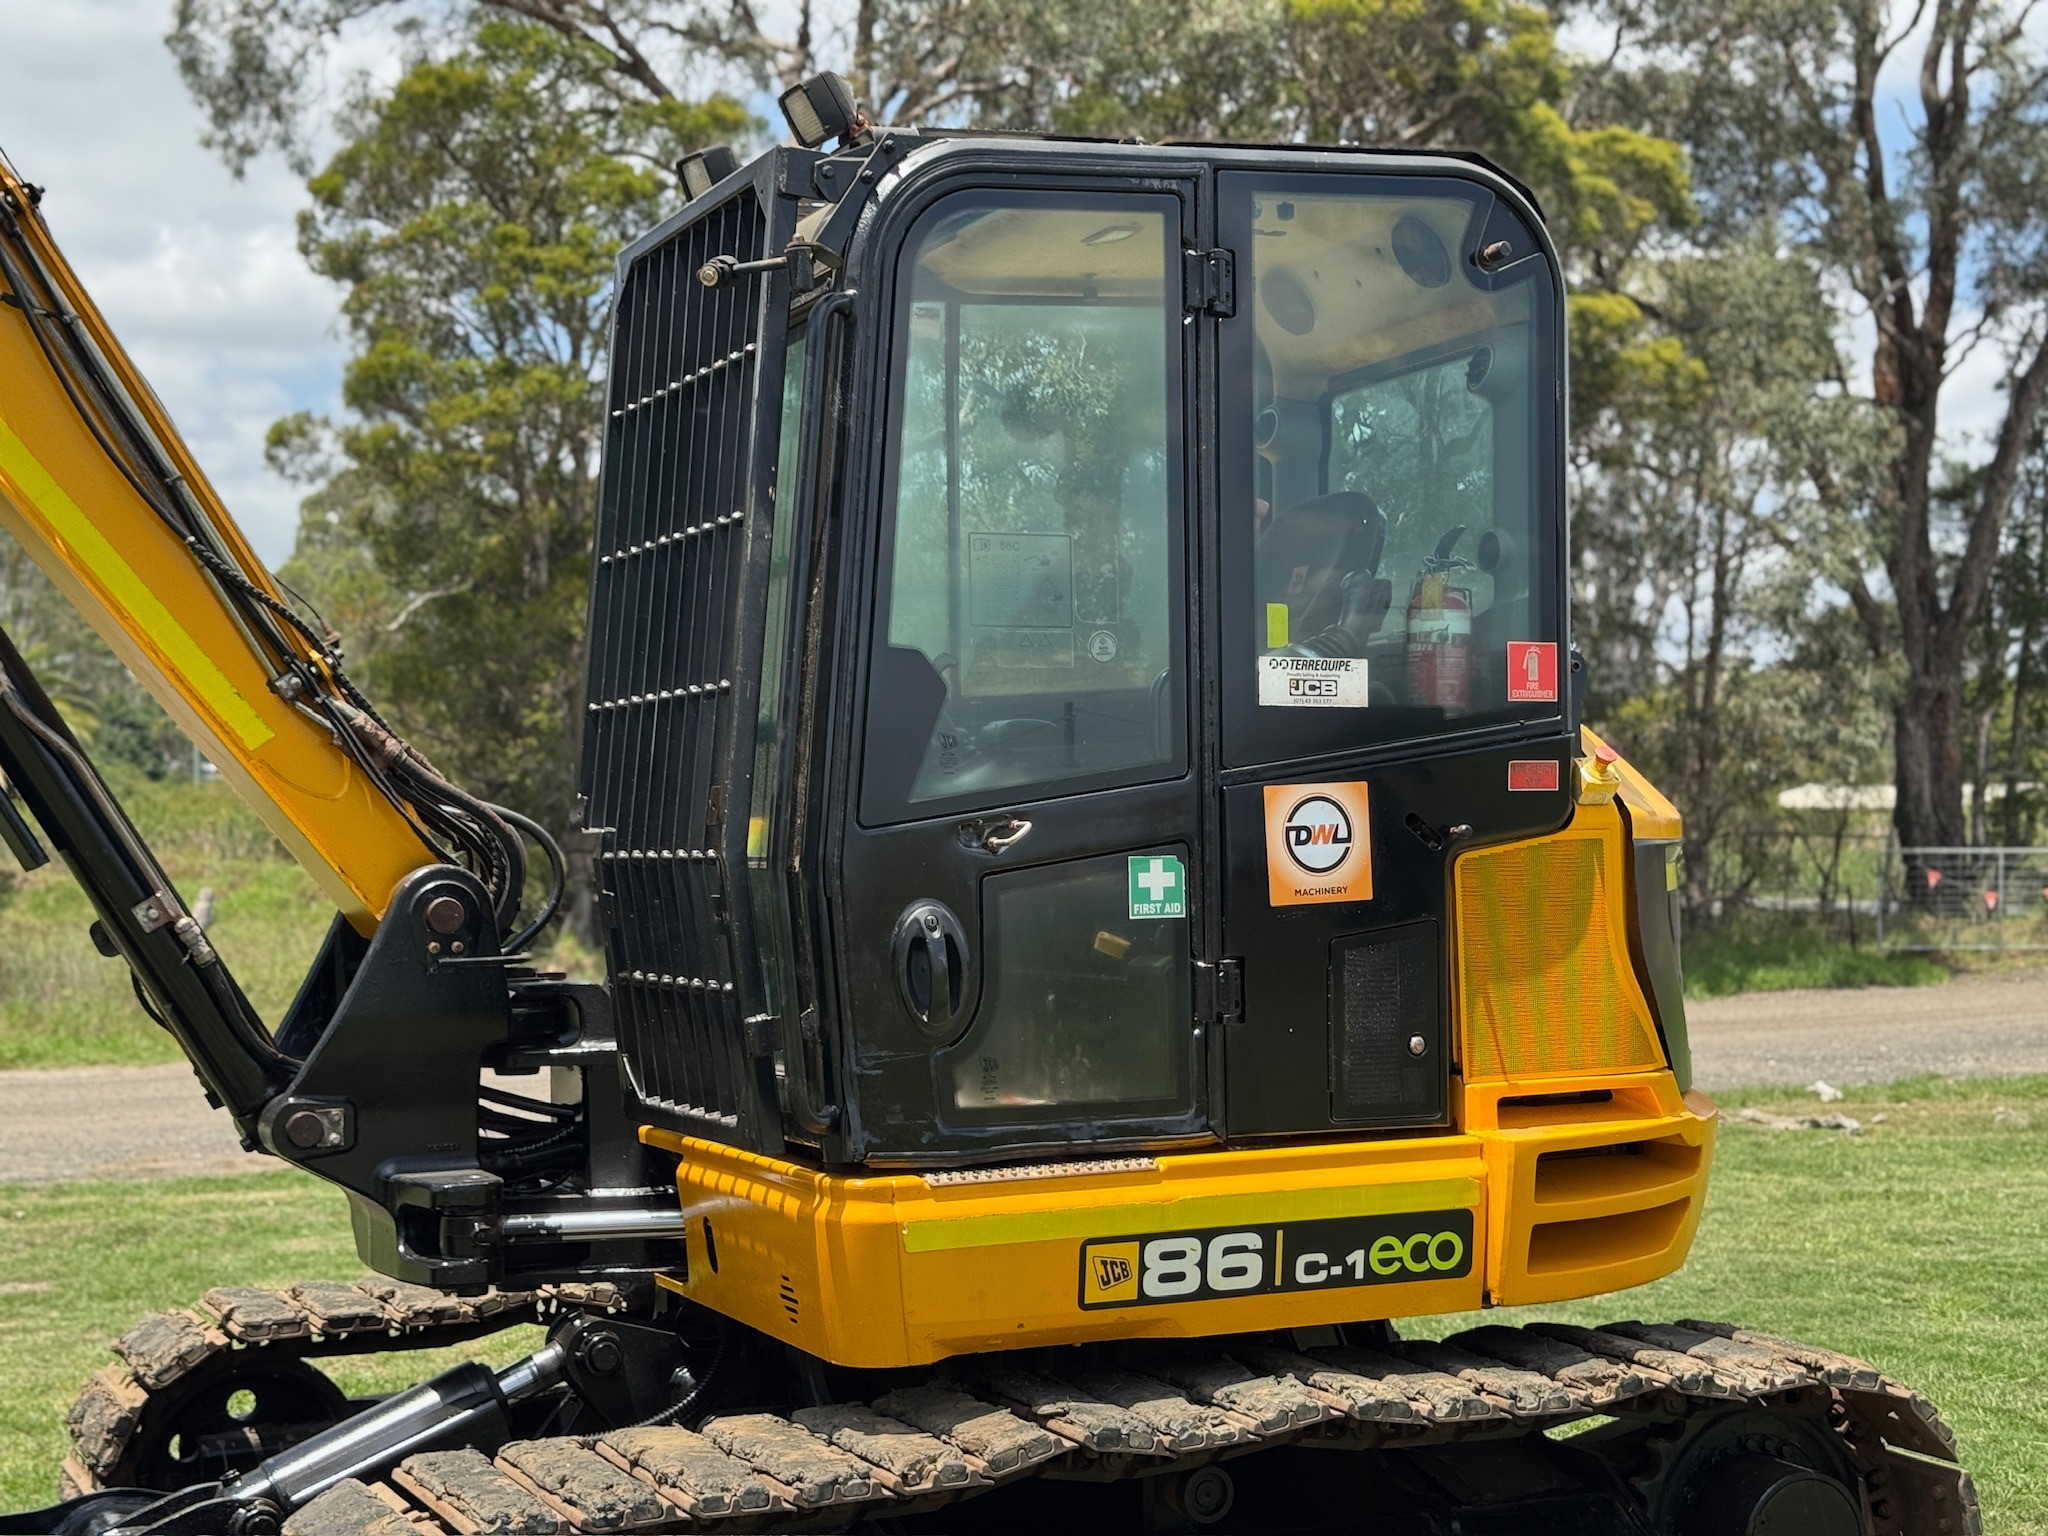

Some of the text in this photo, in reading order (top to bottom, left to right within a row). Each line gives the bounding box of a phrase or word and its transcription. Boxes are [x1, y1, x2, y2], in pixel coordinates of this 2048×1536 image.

[1290, 659, 1351, 671] TERREQUIPE
[1290, 679, 1337, 696] JCB
[1526, 681, 1540, 691] FIRE
[1512, 689, 1554, 699] EXTINGUISHER
[1286, 824, 1352, 846] DWL
[1294, 886, 1348, 897] MACHINERY
[1133, 902, 1181, 915] FIRST AID
[1142, 1231, 1463, 1298] 86 C-1 eco
[1100, 1259, 1130, 1287] JCB
